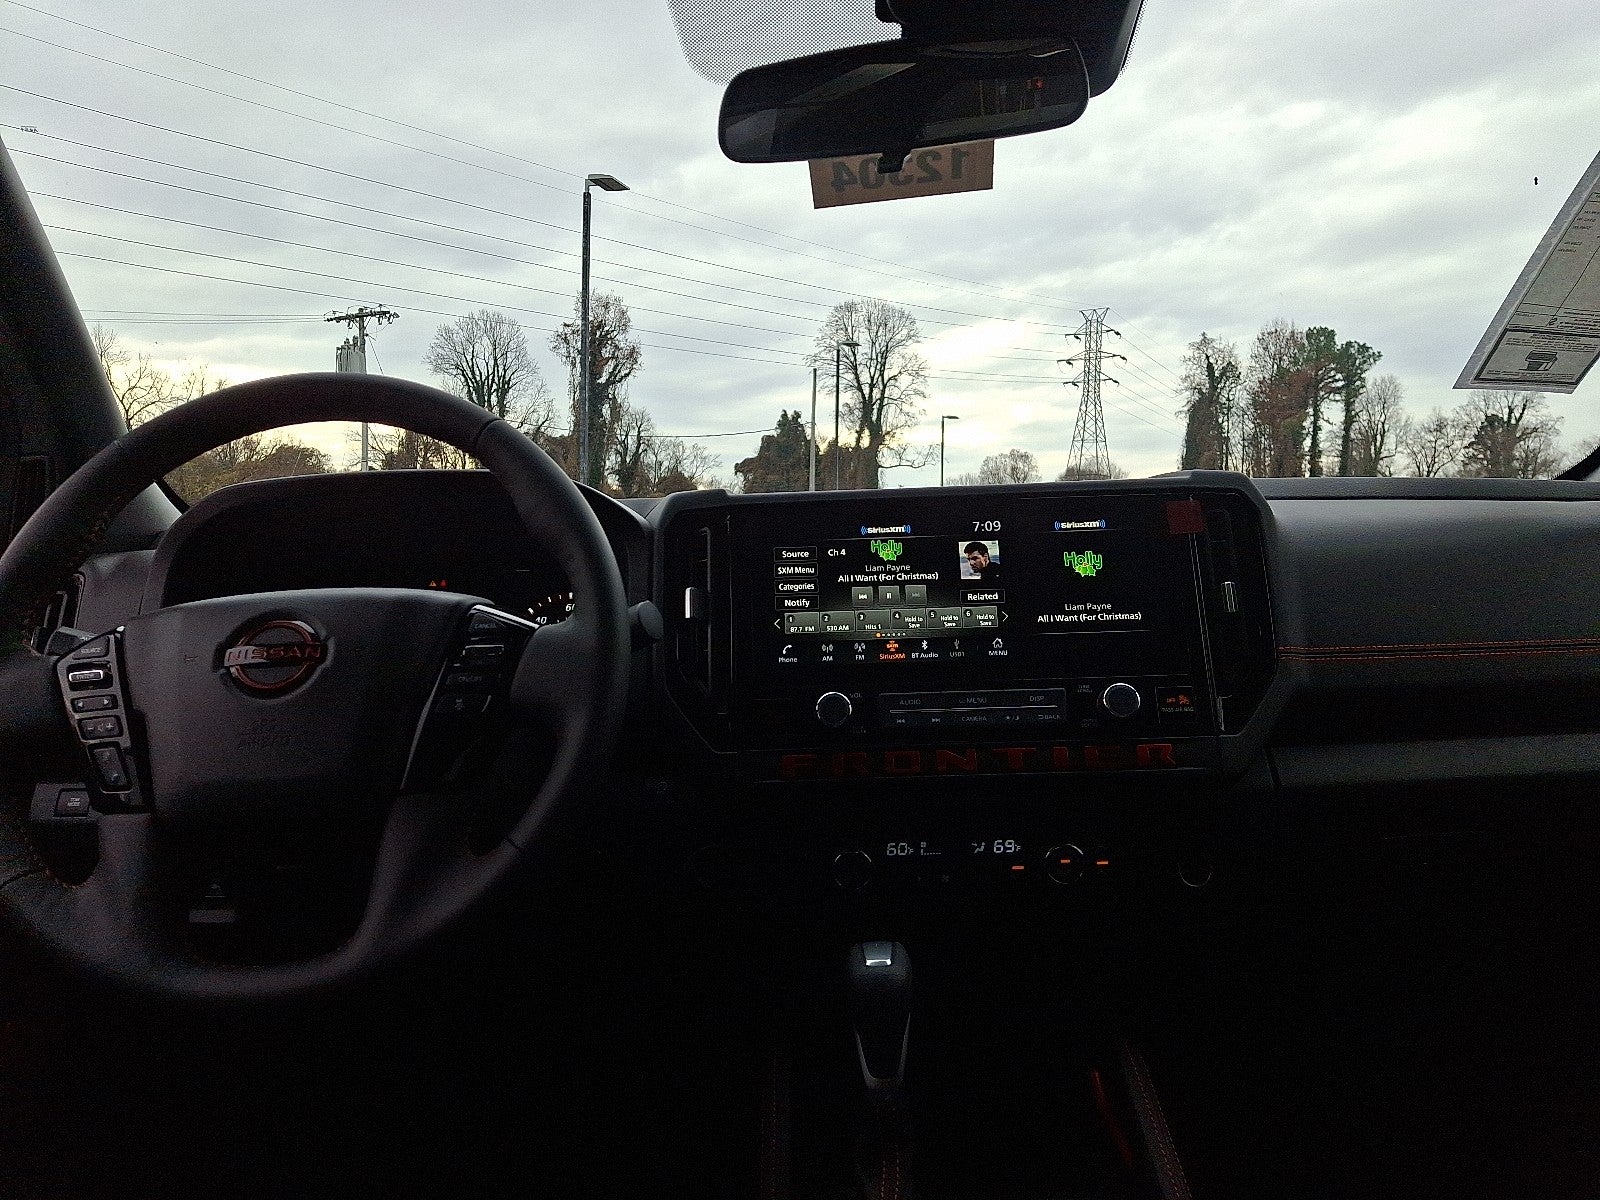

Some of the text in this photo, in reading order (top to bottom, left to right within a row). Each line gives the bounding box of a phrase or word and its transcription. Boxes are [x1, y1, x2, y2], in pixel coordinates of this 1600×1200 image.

[972, 521, 1001, 532] 7:09
[828, 549, 839, 557] Ch
[871, 540, 903, 556] Holly
[782, 550, 809, 558] Source
[1063, 551, 1103, 569] Holly
[778, 566, 815, 575] SXM Menu
[865, 563, 911, 573] Liam Payne
[838, 575, 849, 583] All
[855, 574, 878, 582] Want
[879, 573, 895, 583] (For
[896, 571, 939, 581] Christmas)
[779, 582, 815, 592] Categories
[967, 592, 999, 601] Related
[784, 599, 810, 608] Notify
[1064, 602, 1112, 612] Liam Payne
[1038, 614, 1049, 622] All
[1055, 613, 1078, 621] Want
[1080, 612, 1097, 622] (For
[1098, 611, 1142, 621] Christmas)
[228, 646, 320, 663] NISSAN
[780, 743, 1177, 779] FRONTIER
